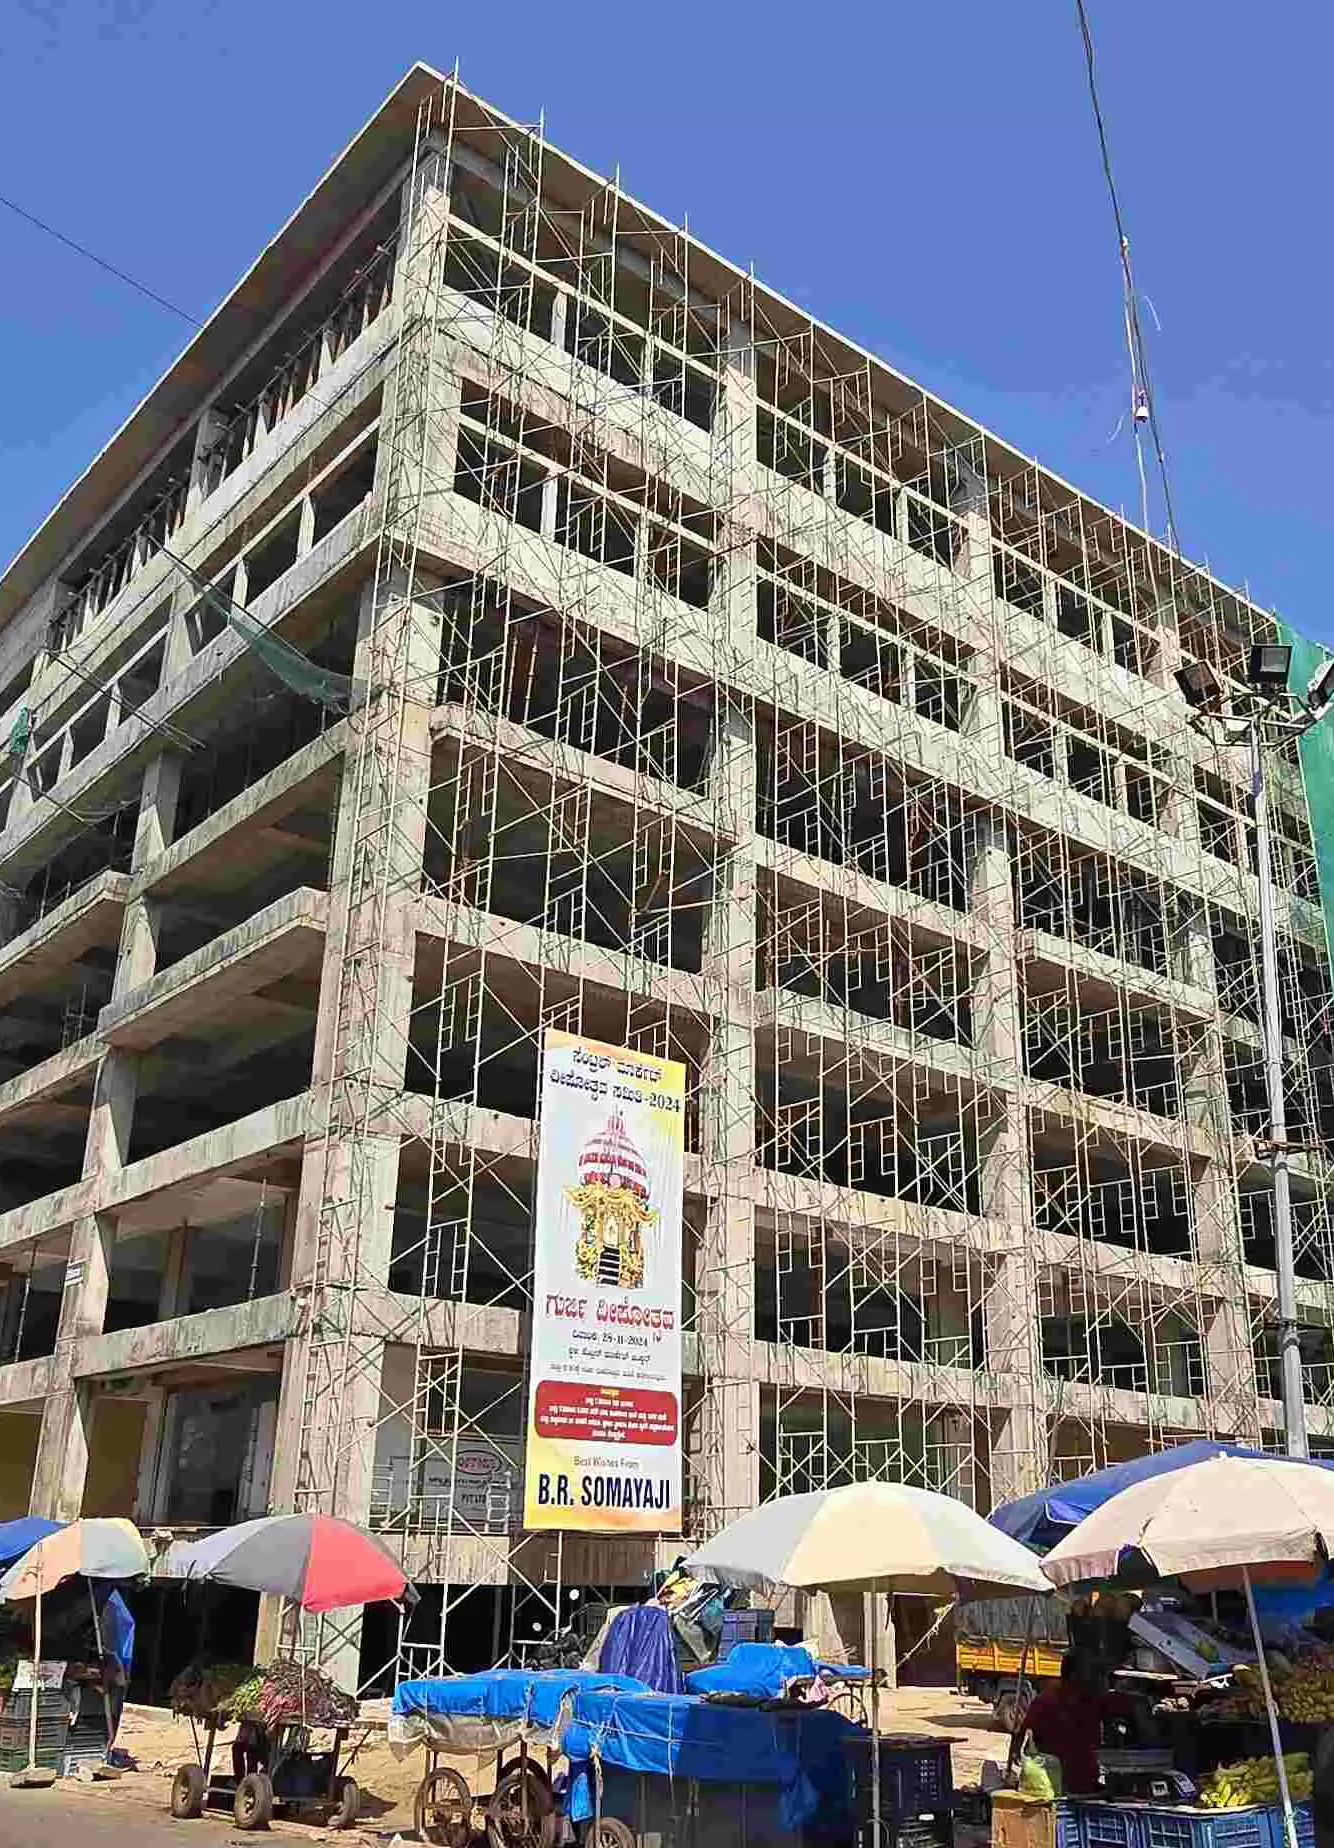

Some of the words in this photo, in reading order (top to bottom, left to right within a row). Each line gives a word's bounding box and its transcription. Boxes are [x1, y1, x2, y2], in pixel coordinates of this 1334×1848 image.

[574, 1456, 591, 1467] Best
[593, 1457, 618, 1468] Wishes
[621, 1458, 640, 1469] From
[538, 1473, 574, 1506] B.R.
[581, 1475, 670, 1509] SOMAYAJI
